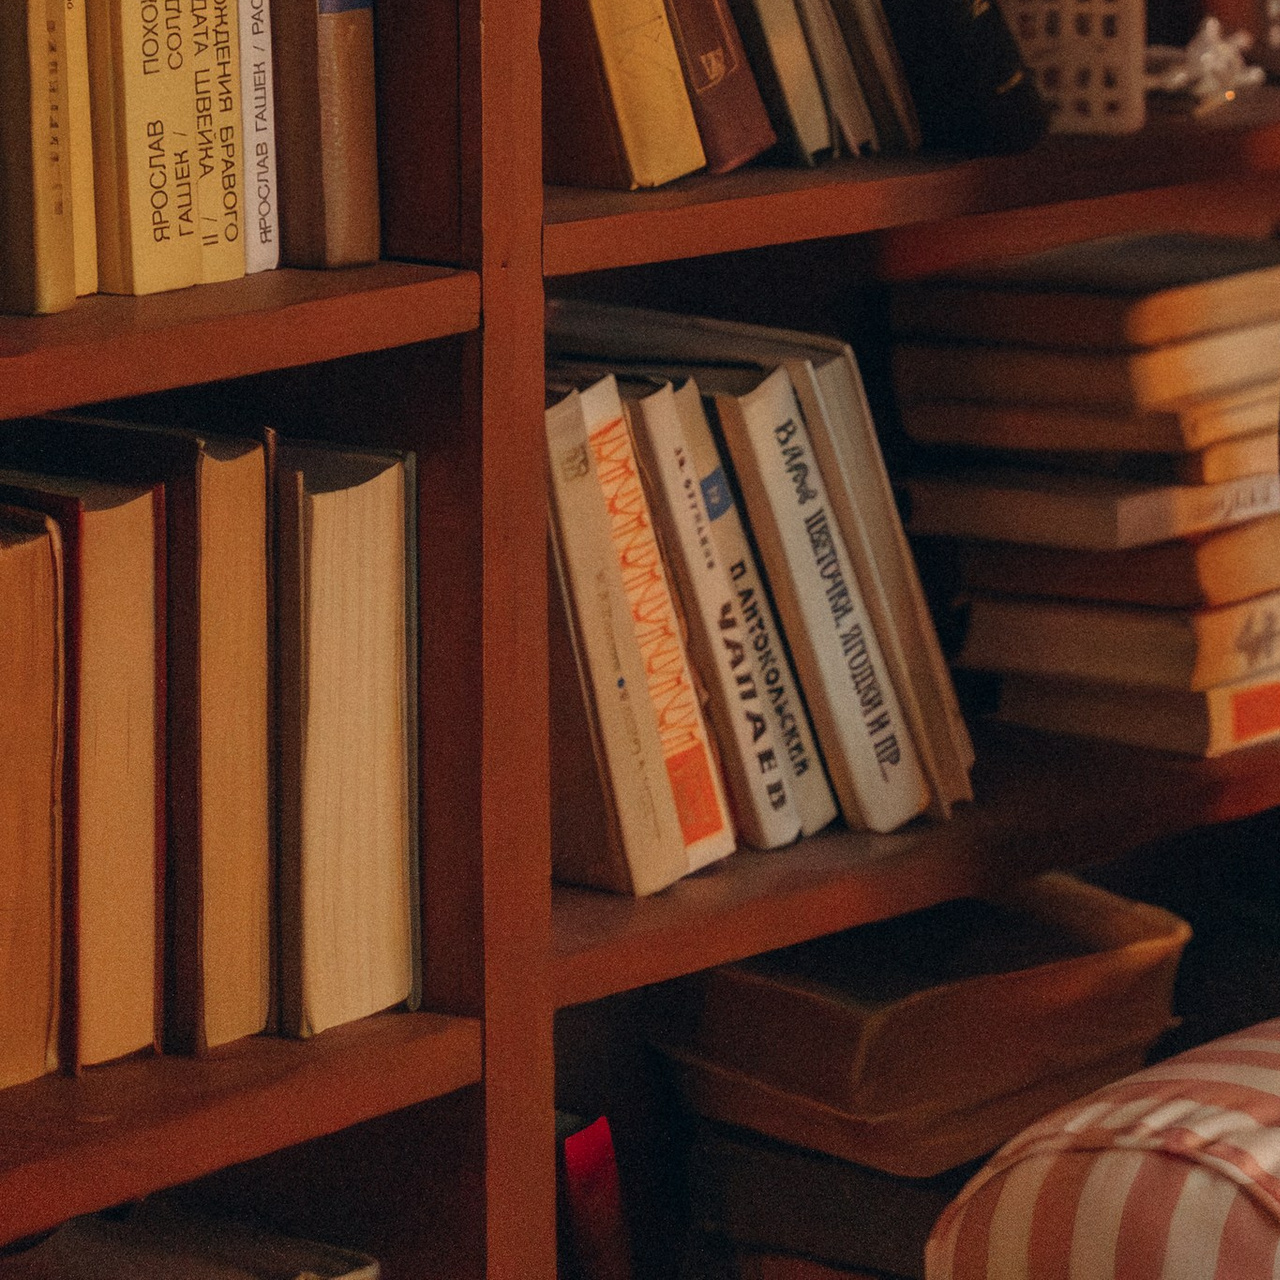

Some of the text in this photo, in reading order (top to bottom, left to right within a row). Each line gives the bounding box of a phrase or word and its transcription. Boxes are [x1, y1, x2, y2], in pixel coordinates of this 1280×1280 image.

[195, 65, 216, 180] ШВЕЙКА
[252, 61, 269, 134] ГАШЕК
[148, 118, 172, 244] ЯРОСЛАВ
[174, 148, 195, 238] ГАШЕК
[219, 126, 240, 244] БРАВОГО
[253, 142, 273, 245] ЯРОСЛАВ
[719, 601, 787, 812] ЧАПАЕВ
